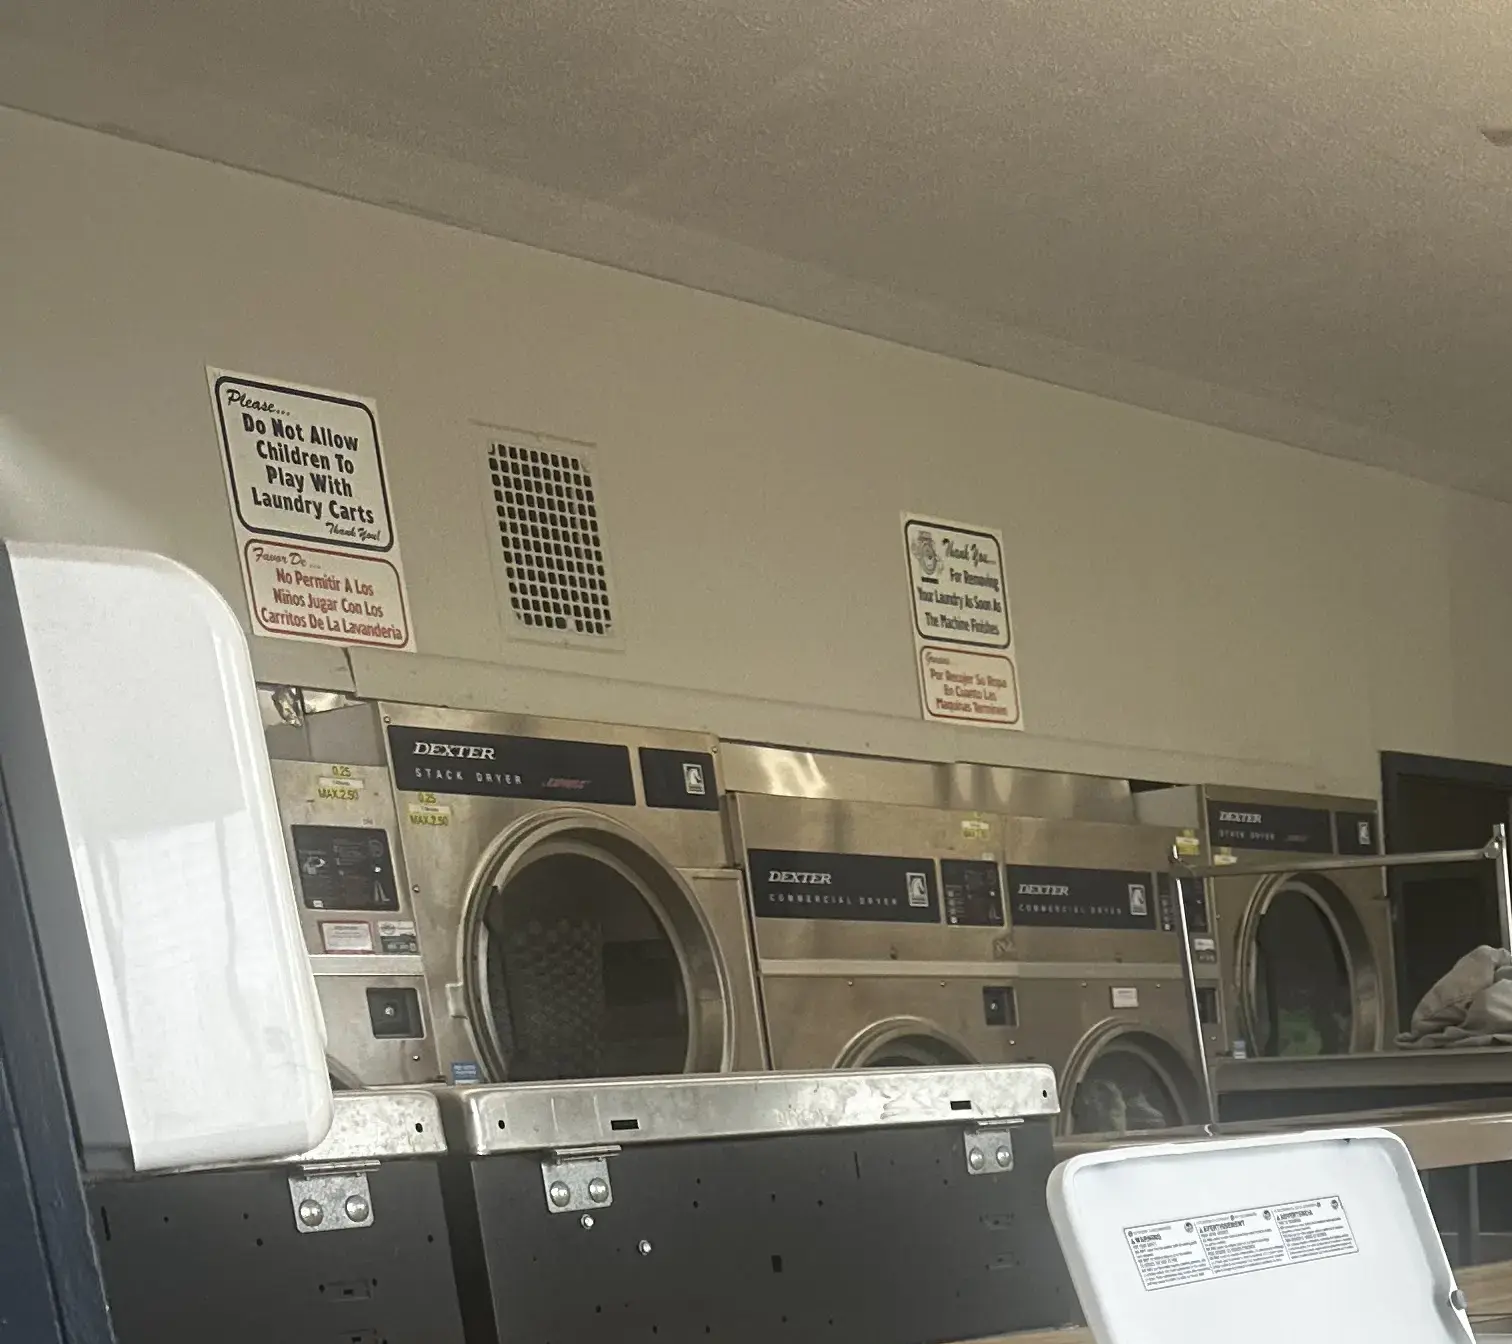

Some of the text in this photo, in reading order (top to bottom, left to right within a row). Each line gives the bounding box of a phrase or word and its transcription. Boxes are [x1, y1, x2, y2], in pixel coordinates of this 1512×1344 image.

[242, 412, 359, 451] Do Not Allow
[256, 440, 354, 474] Children To
[266, 465, 353, 497] Play With
[251, 487, 375, 524] Laundry Carts
[325, 522, 356, 537] Thank
[252, 547, 288, 565] Favor
[276, 567, 374, 597] No Permitir A Los
[272, 587, 384, 618] Niños Jugar Con Los
[261, 607, 307, 629] Carritos
[308, 613, 325, 630] De
[326, 616, 341, 632] La
[413, 741, 496, 760] DEXTER
[415, 767, 523, 785] STACK DRYER
[1219, 811, 1262, 823] DEXTER
[768, 870, 832, 885] DEXTER
[769, 893, 852, 905] COMMERCIAL
[1018, 884, 1069, 896] DEXTER
